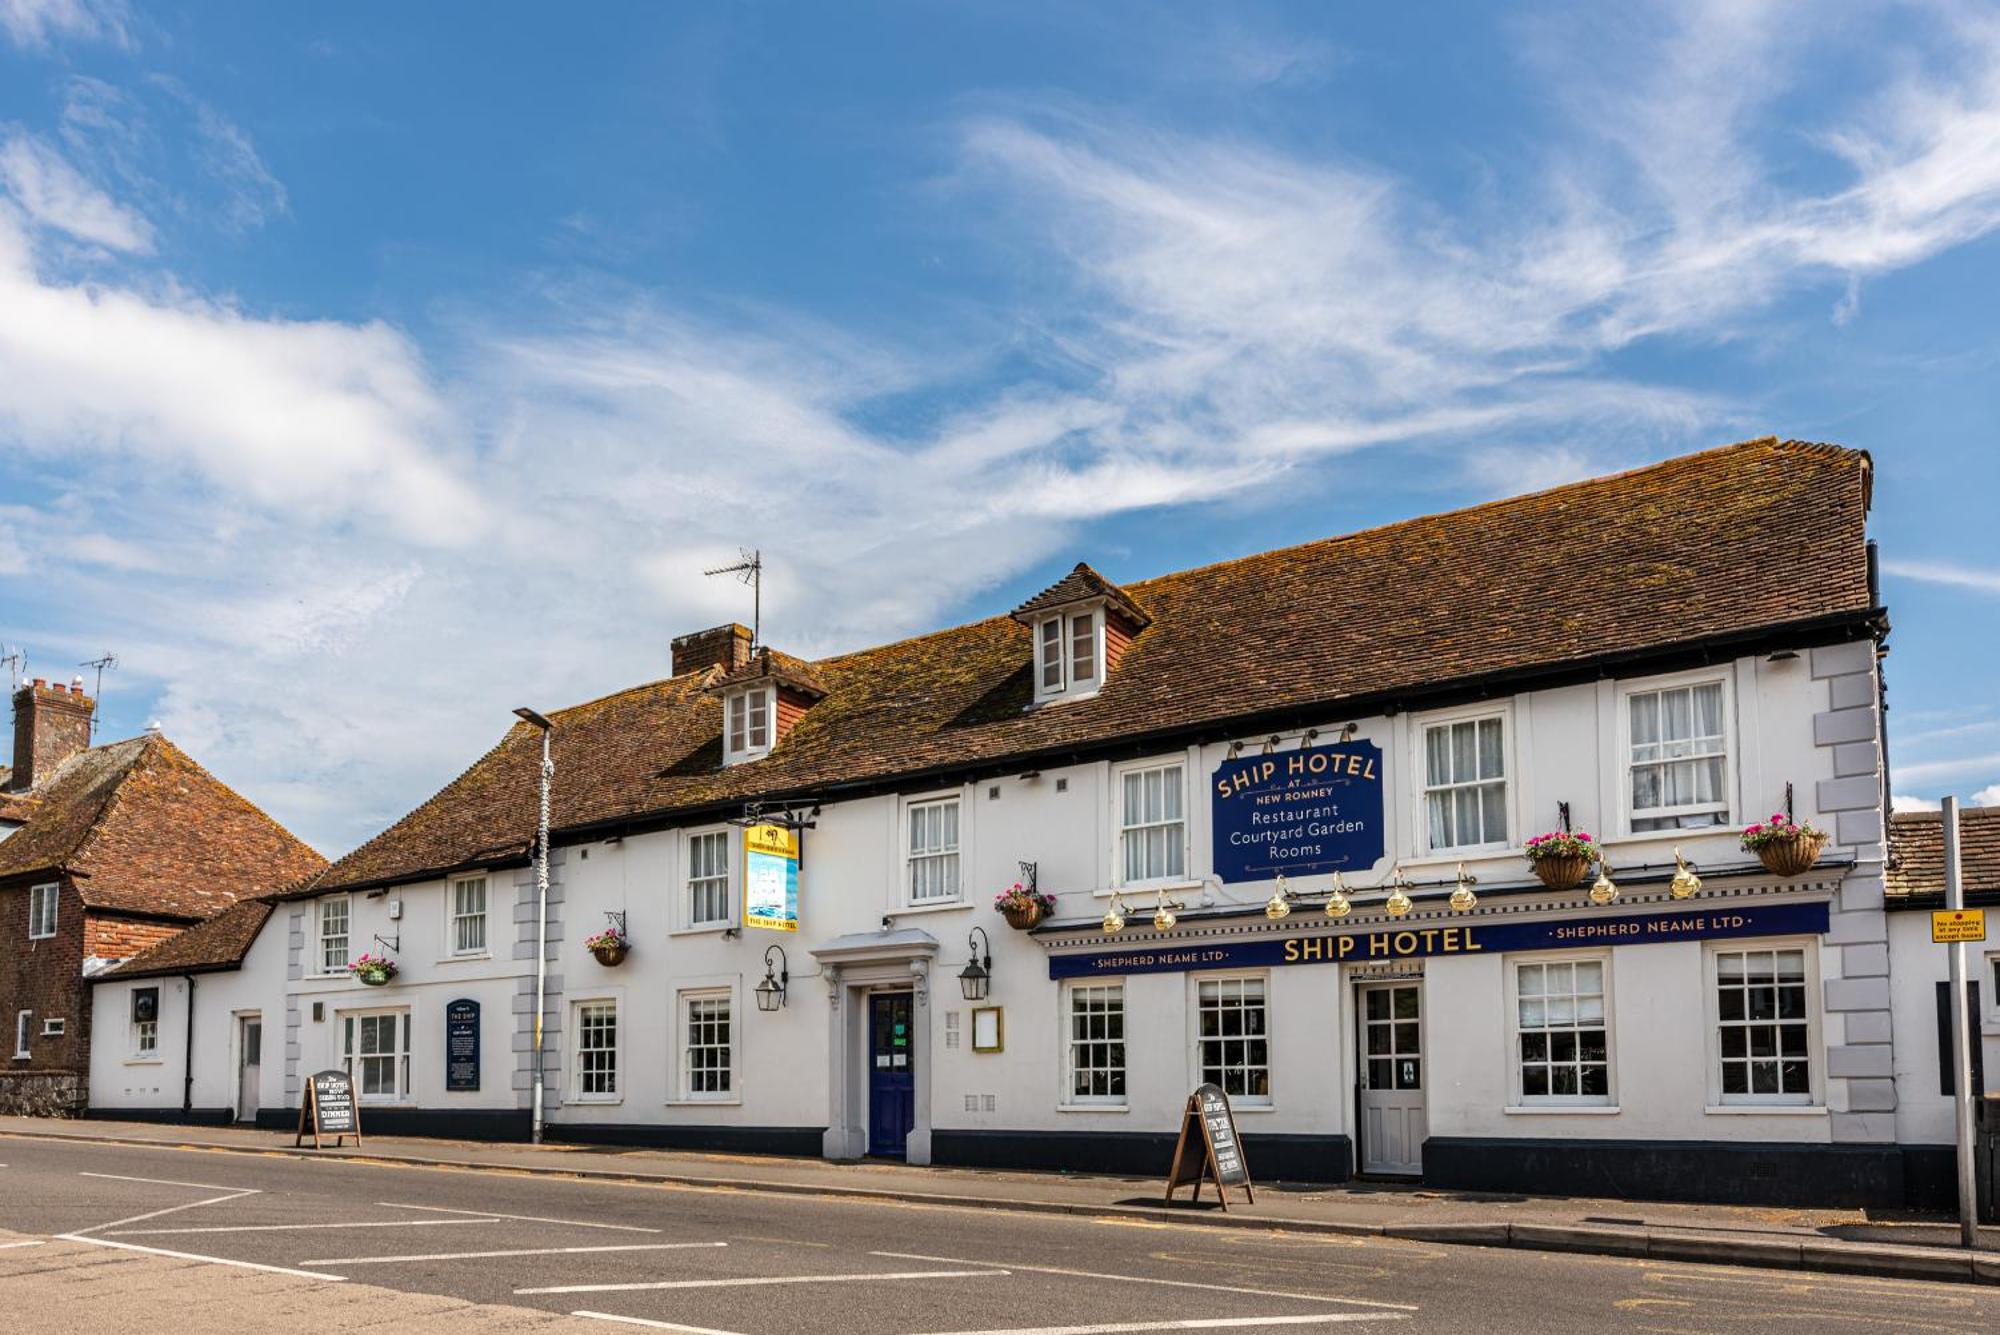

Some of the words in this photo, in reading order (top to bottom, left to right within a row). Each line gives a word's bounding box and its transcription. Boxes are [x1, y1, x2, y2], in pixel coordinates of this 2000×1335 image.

[1218, 761, 1275, 798] SHIP
[1288, 753, 1376, 780] HOTEL
[1288, 780, 1301, 789] AT
[1256, 794, 1281, 805] NEW
[1285, 787, 1333, 802] ROMNEY
[1252, 804, 1339, 825] Restaurant
[1230, 825, 1303, 845] Courtyard
[1308, 820, 1364, 836] Garden
[1270, 844, 1321, 859] Rooms
[1557, 923, 1640, 939] SHEPHERD
[1647, 918, 1705, 933] NEAME
[1712, 916, 1744, 928] LTD
[1284, 935, 1354, 961] SHIP
[1369, 927, 1482, 956] HOTEL
[1097, 955, 1154, 968] SHEPHERD
[1159, 953, 1197, 964] NEAME
[1202, 951, 1223, 961] LTD
